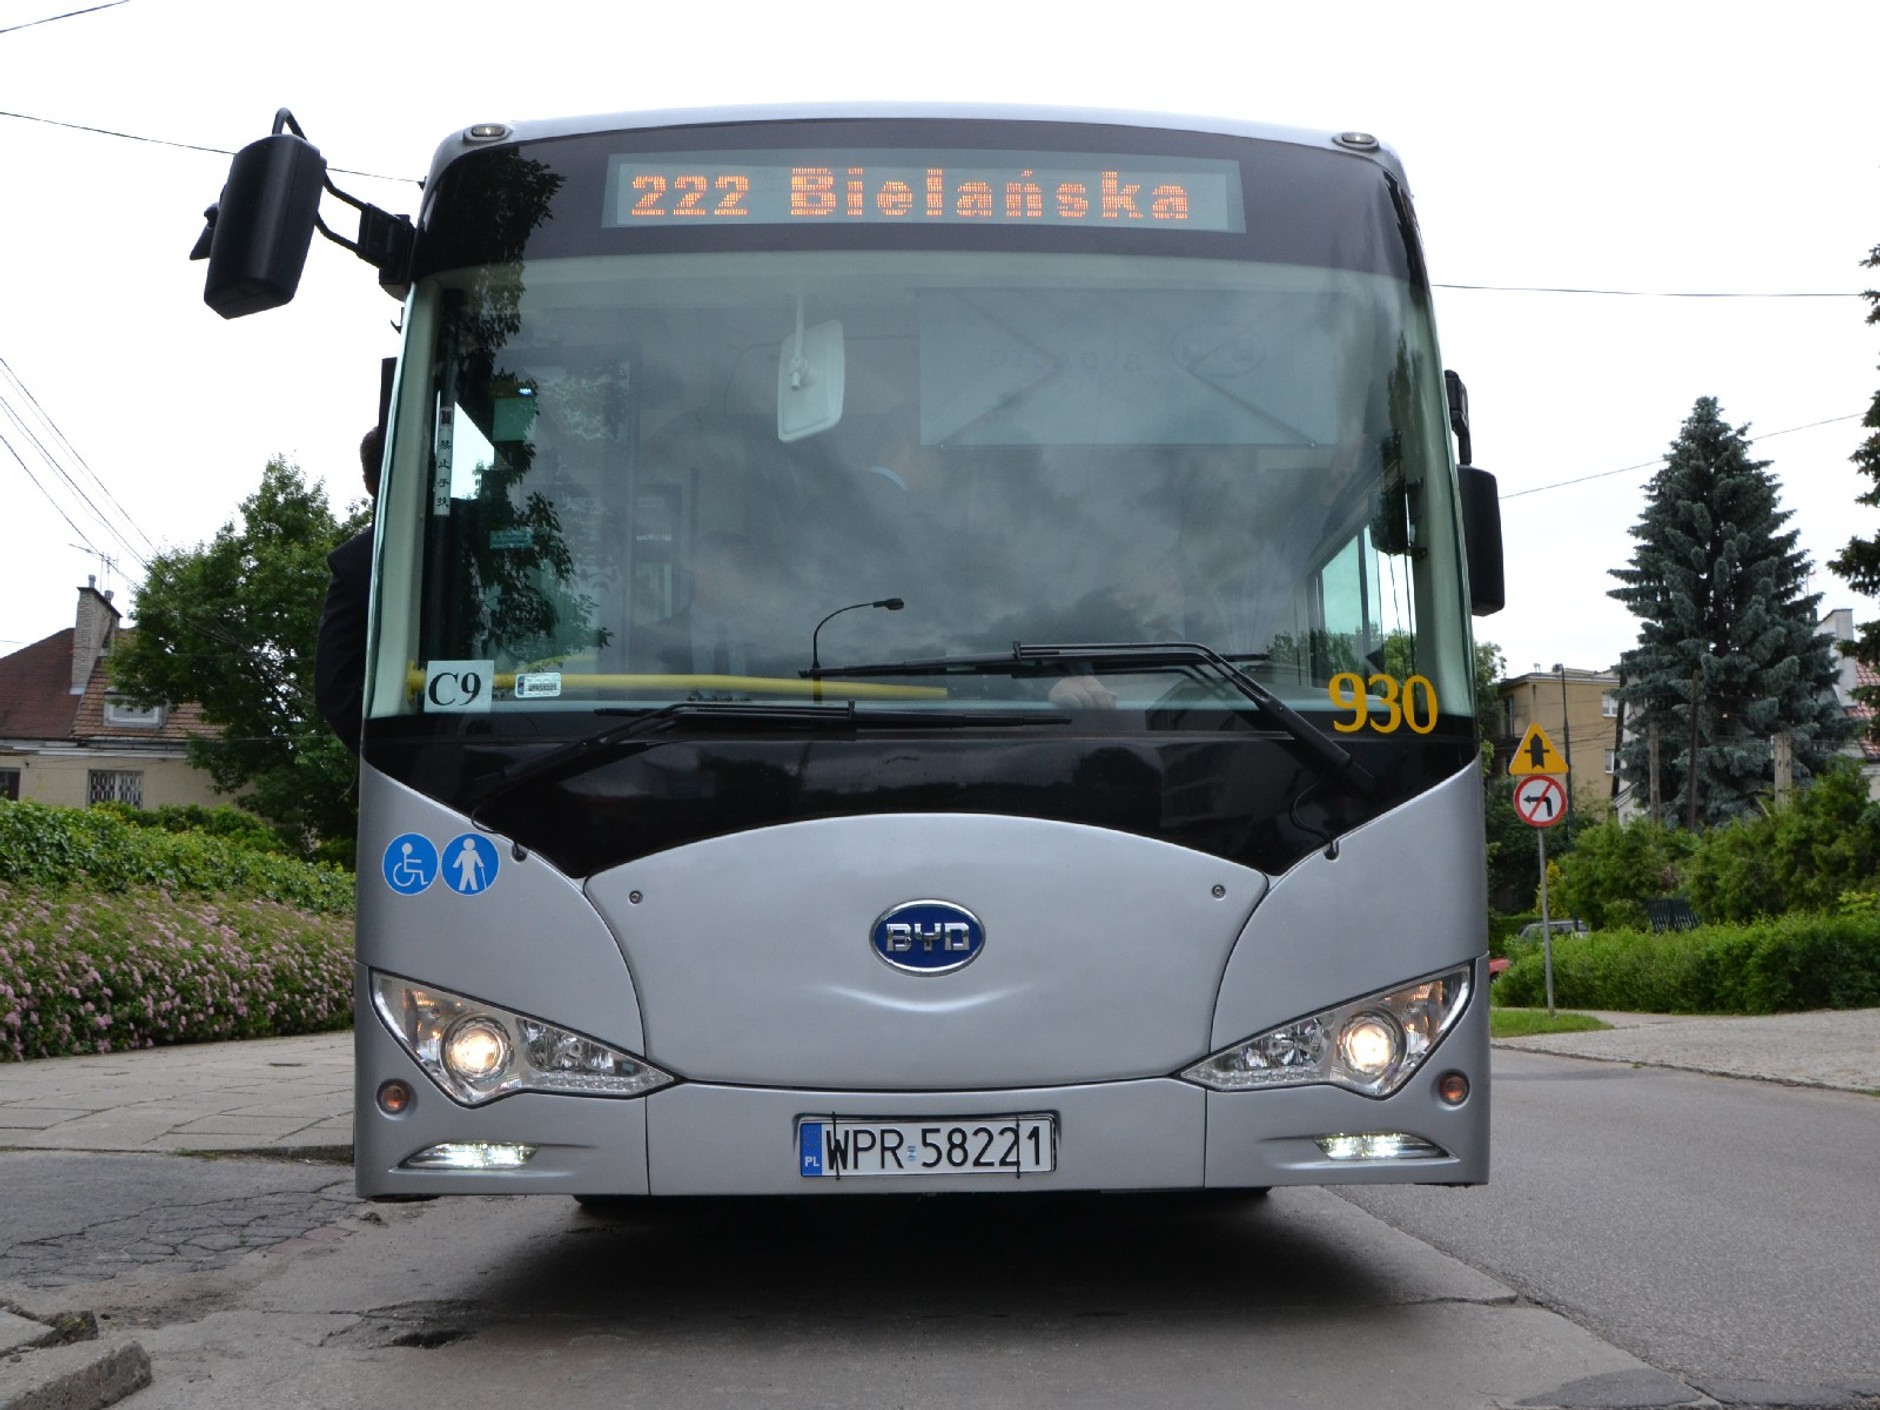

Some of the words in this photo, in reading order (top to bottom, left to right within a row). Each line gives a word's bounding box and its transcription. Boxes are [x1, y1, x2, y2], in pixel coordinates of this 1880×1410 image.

[632, 175, 749, 216] 222
[791, 167, 1188, 218] Bielańska
[428, 672, 481, 707] C9
[1328, 672, 1438, 735] 930
[886, 922, 970, 952] BYD
[804, 1156, 821, 1168] PL
[826, 1127, 905, 1170] WPR
[920, 1125, 1041, 1168] 58221
